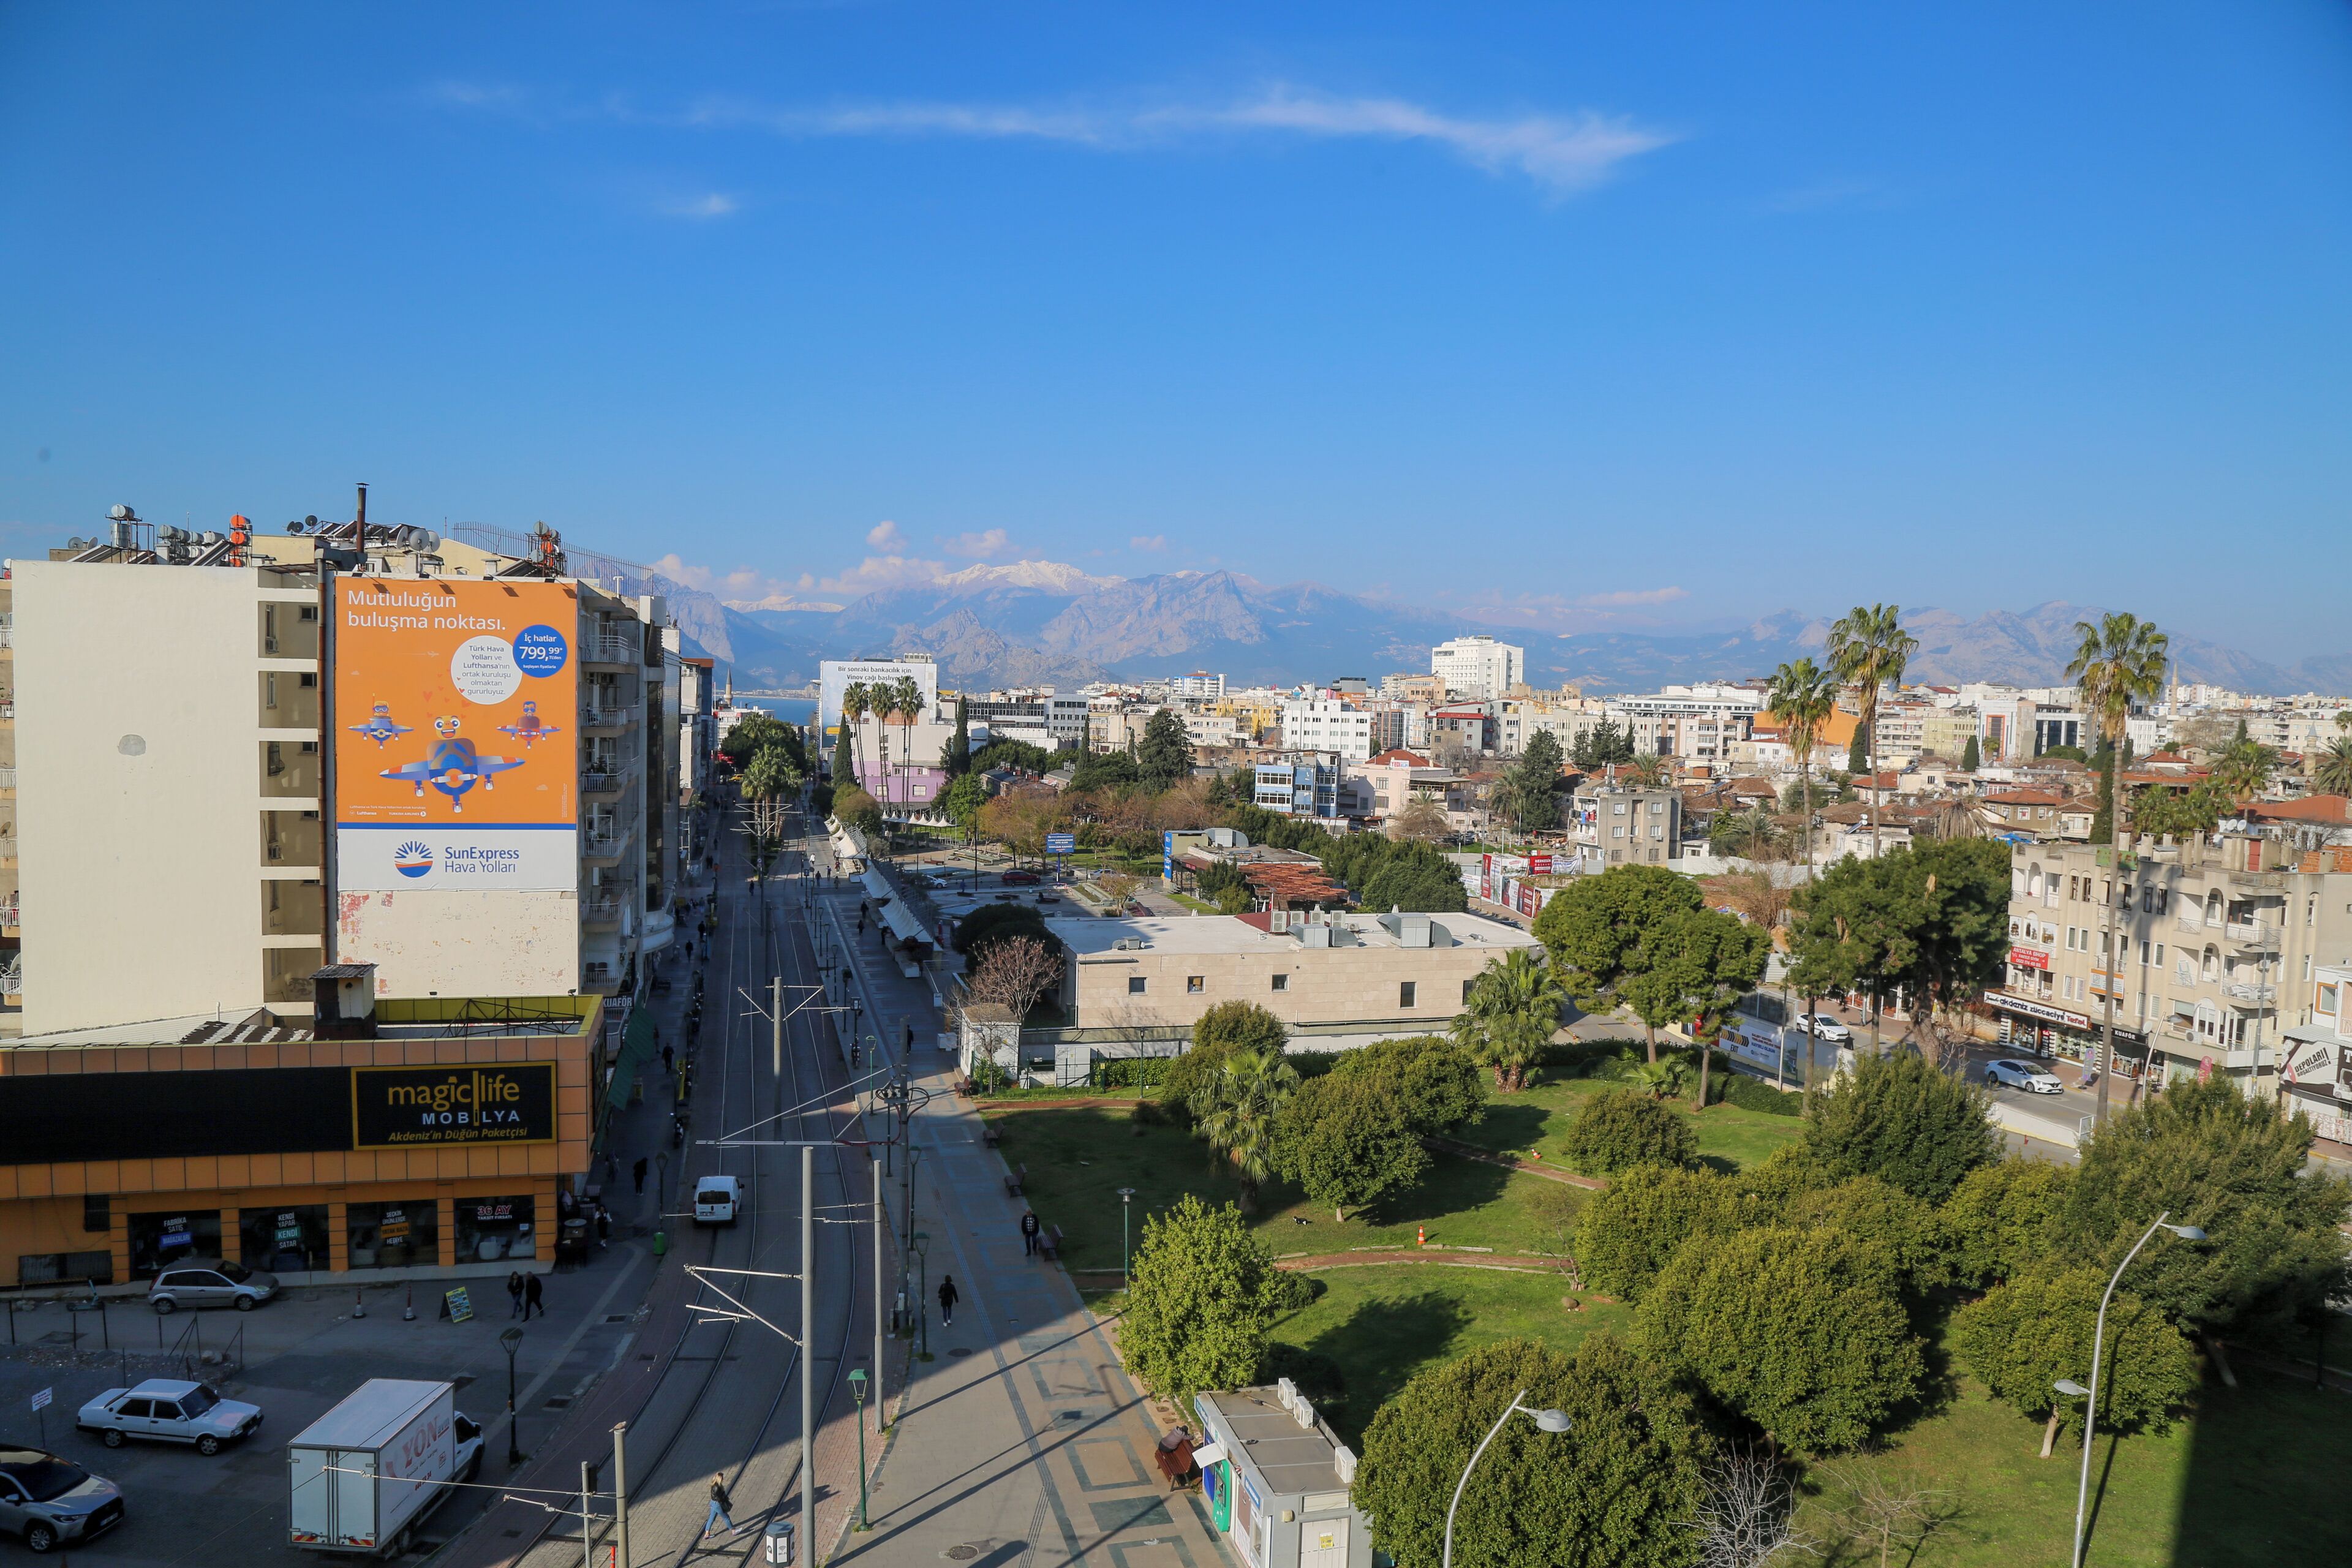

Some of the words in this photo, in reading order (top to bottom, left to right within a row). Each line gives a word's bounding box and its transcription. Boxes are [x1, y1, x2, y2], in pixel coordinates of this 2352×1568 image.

[348, 590, 456, 611] Mutluluğun
[348, 611, 428, 631] buluşma
[434, 614, 506, 630] noktası.
[524, 633, 532, 643] İç
[445, 846, 519, 862] SunExpress
[445, 861, 475, 872] Hava
[479, 861, 516, 873] Yolları
[2000, 998, 2029, 1011] akdeniz
[2114, 1030, 2136, 1040] KUAFÖR
[388, 1131, 442, 1142] Akdeniz'in
[445, 1128, 478, 1140] Düğün
[481, 1127, 528, 1139] Paketçisi
[477, 1205, 492, 1215] 36
[495, 1205, 512, 1215] AY
[164, 1216, 187, 1227] FABRİKA
[278, 1212, 295, 1221] KENDİ
[168, 1224, 183, 1233] SATIŞ
[278, 1227, 298, 1239] KENDİ
[279, 1240, 297, 1248] SATAR
